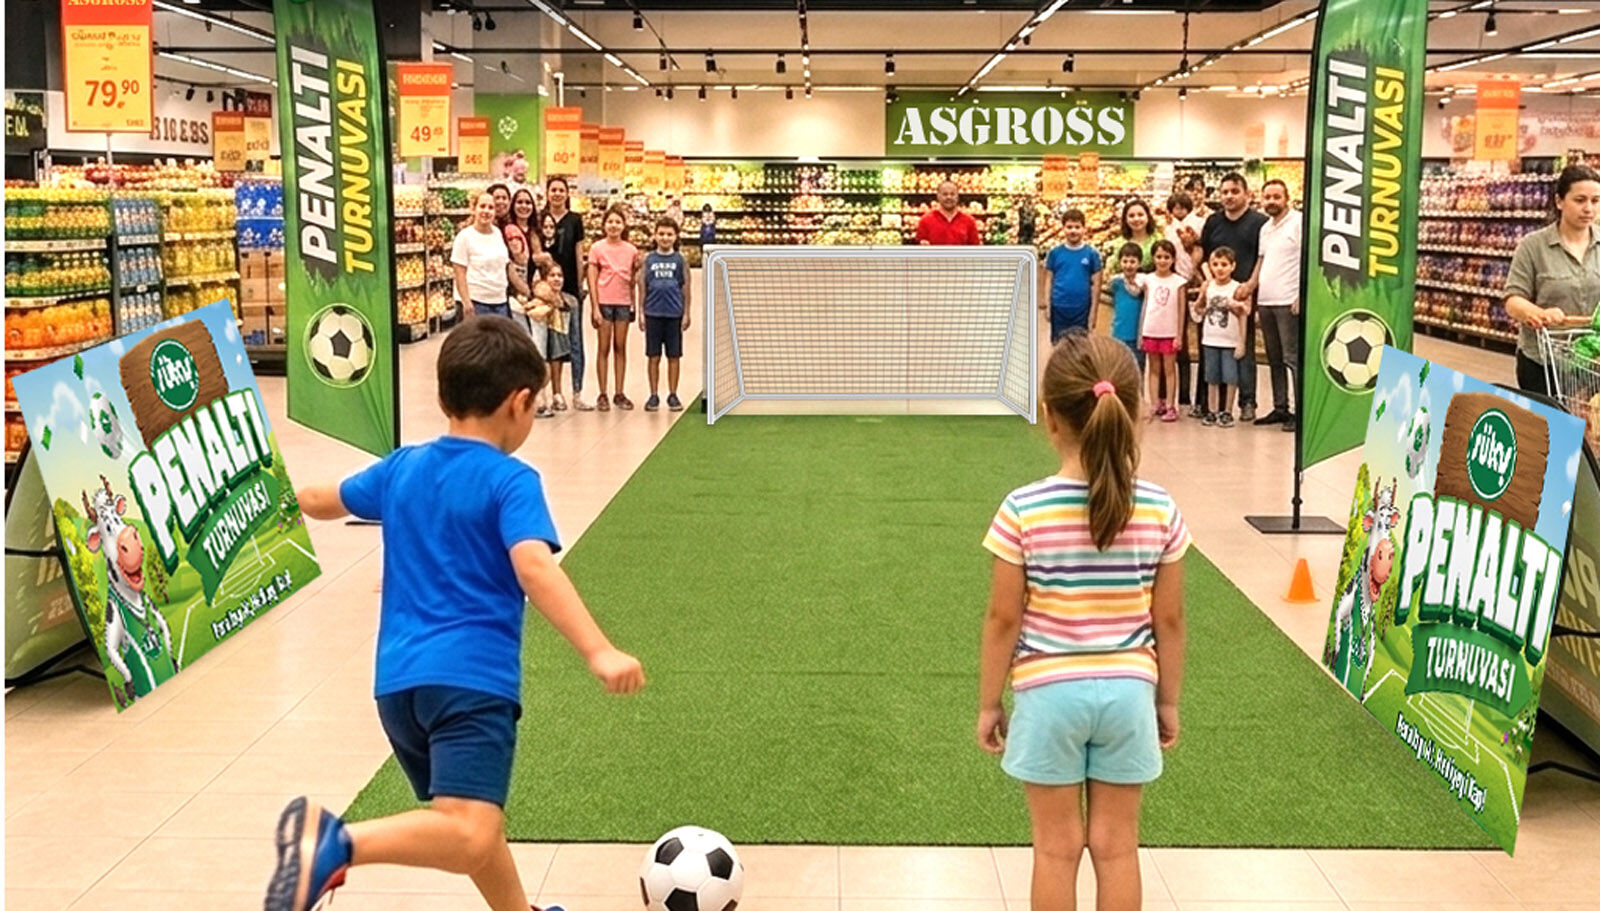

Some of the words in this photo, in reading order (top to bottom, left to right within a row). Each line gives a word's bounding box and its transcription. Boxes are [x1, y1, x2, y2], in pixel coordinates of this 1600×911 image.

[290, 45, 338, 265] PENALTI
[336, 58, 375, 275] TURNUVASI
[894, 106, 1126, 146] ASGROSS
[1322, 59, 1367, 270] PENALTI
[1369, 67, 1405, 278] TURNUVASI
[131, 390, 272, 562] PENALTI
[202, 480, 270, 569] TURNUVASI
[1402, 496, 1561, 655] PENALTI
[1426, 637, 1517, 703] TURNUVASI
